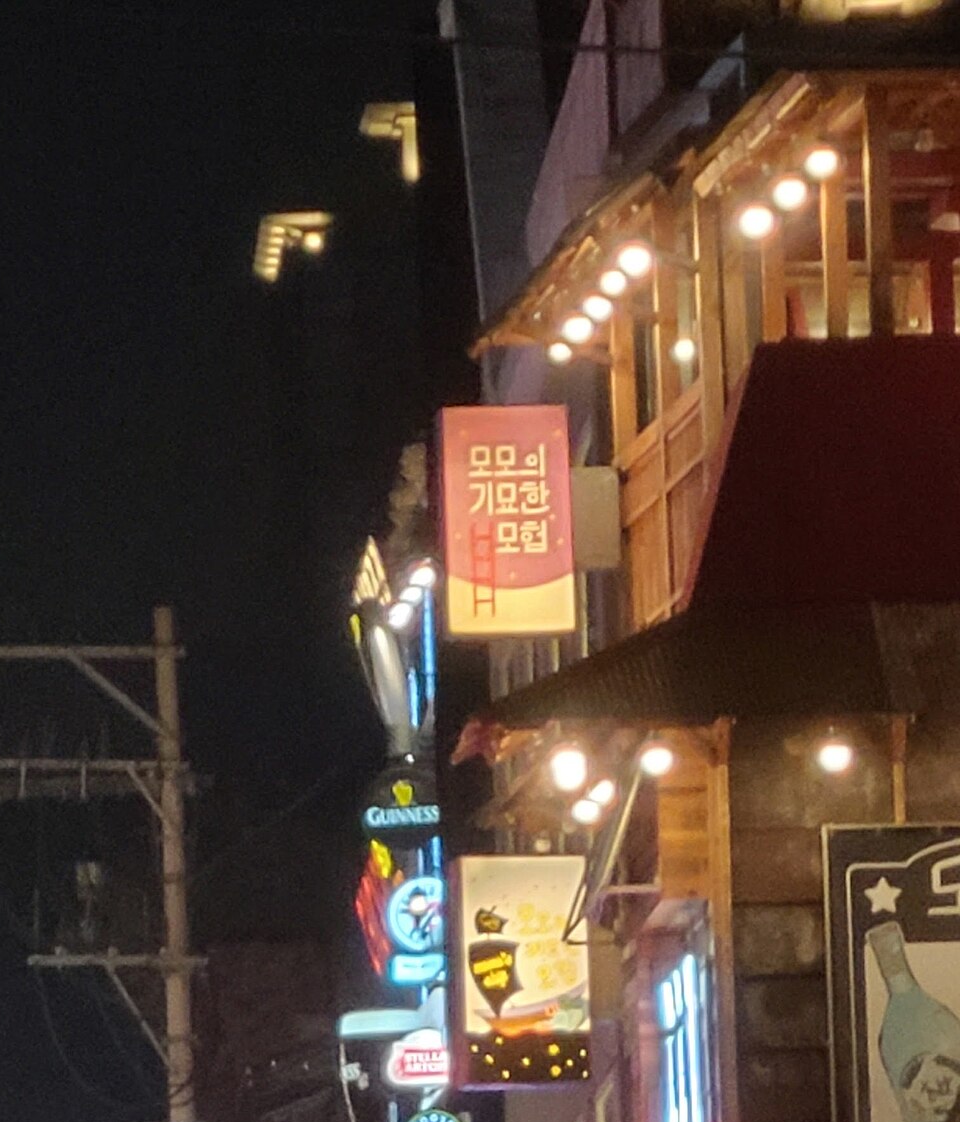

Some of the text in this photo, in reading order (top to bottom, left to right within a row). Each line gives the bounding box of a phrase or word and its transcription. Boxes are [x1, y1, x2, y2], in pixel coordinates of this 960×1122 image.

[468, 443, 545, 477] 모모의
[468, 480, 550, 516] 기묘한
[496, 520, 548, 553] 모험
[366, 805, 440, 827] GUINNESS
